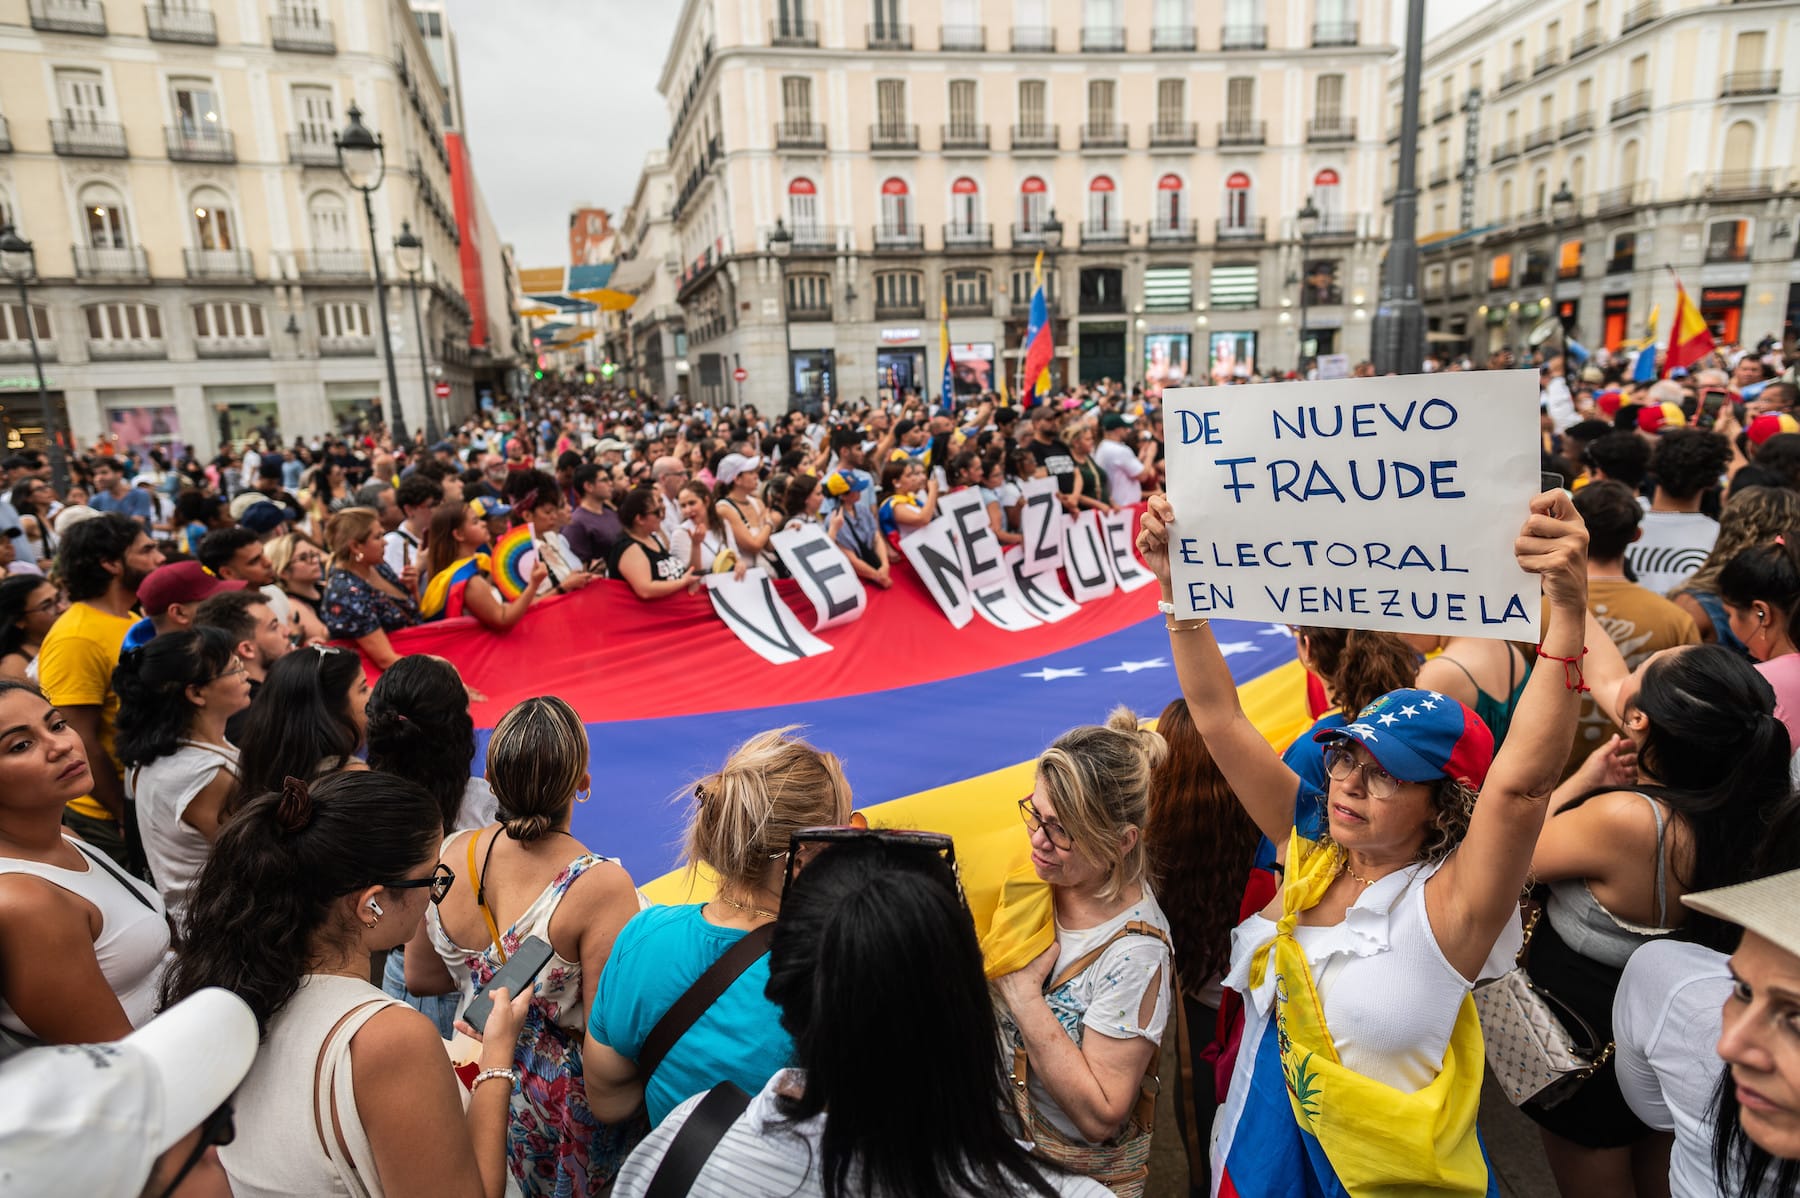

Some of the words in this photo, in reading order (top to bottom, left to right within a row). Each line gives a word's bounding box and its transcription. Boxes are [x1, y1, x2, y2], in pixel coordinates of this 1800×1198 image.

[1174, 409, 1223, 445] DE
[1272, 398, 1458, 440] NUEVO
[1214, 457, 1466, 503] FRAUDE
[1180, 538, 1469, 573] ELECTORAL
[1188, 582, 1235, 612] EN
[1264, 585, 1530, 625] VENEZUELA
